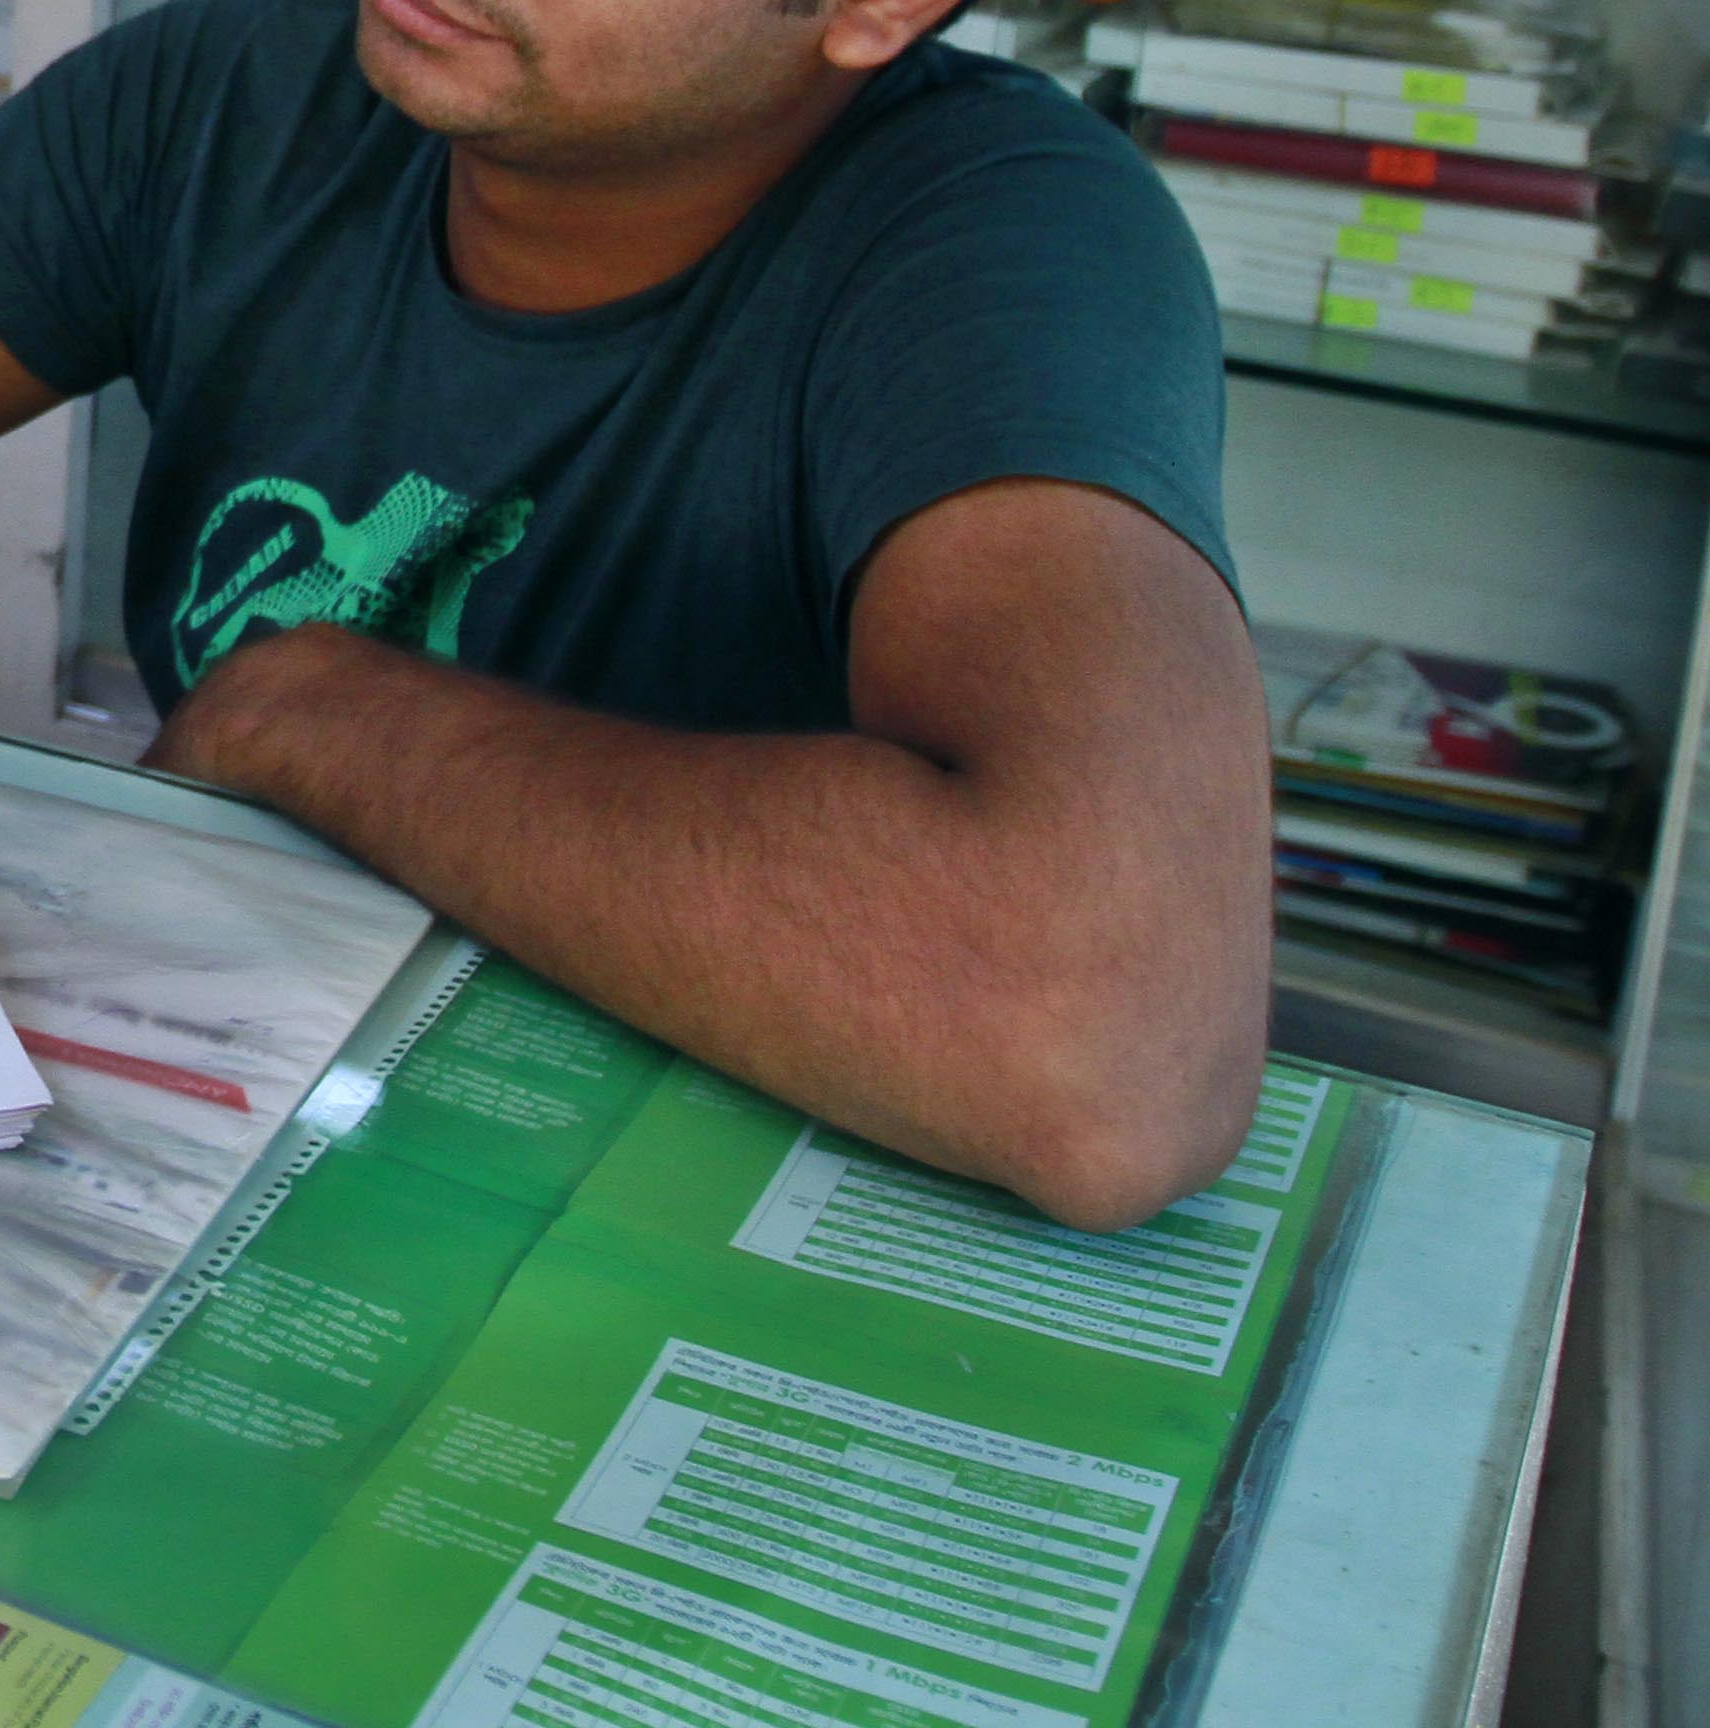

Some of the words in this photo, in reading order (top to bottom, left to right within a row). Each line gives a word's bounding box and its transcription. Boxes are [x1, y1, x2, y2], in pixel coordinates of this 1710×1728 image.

[774, 1385, 810, 1404] 3G
[1066, 1453, 1082, 1467] 2
[1091, 1461, 1166, 1489] Mbps
[605, 1582, 644, 1604] 3G
[883, 1666, 964, 1700] Mbps
